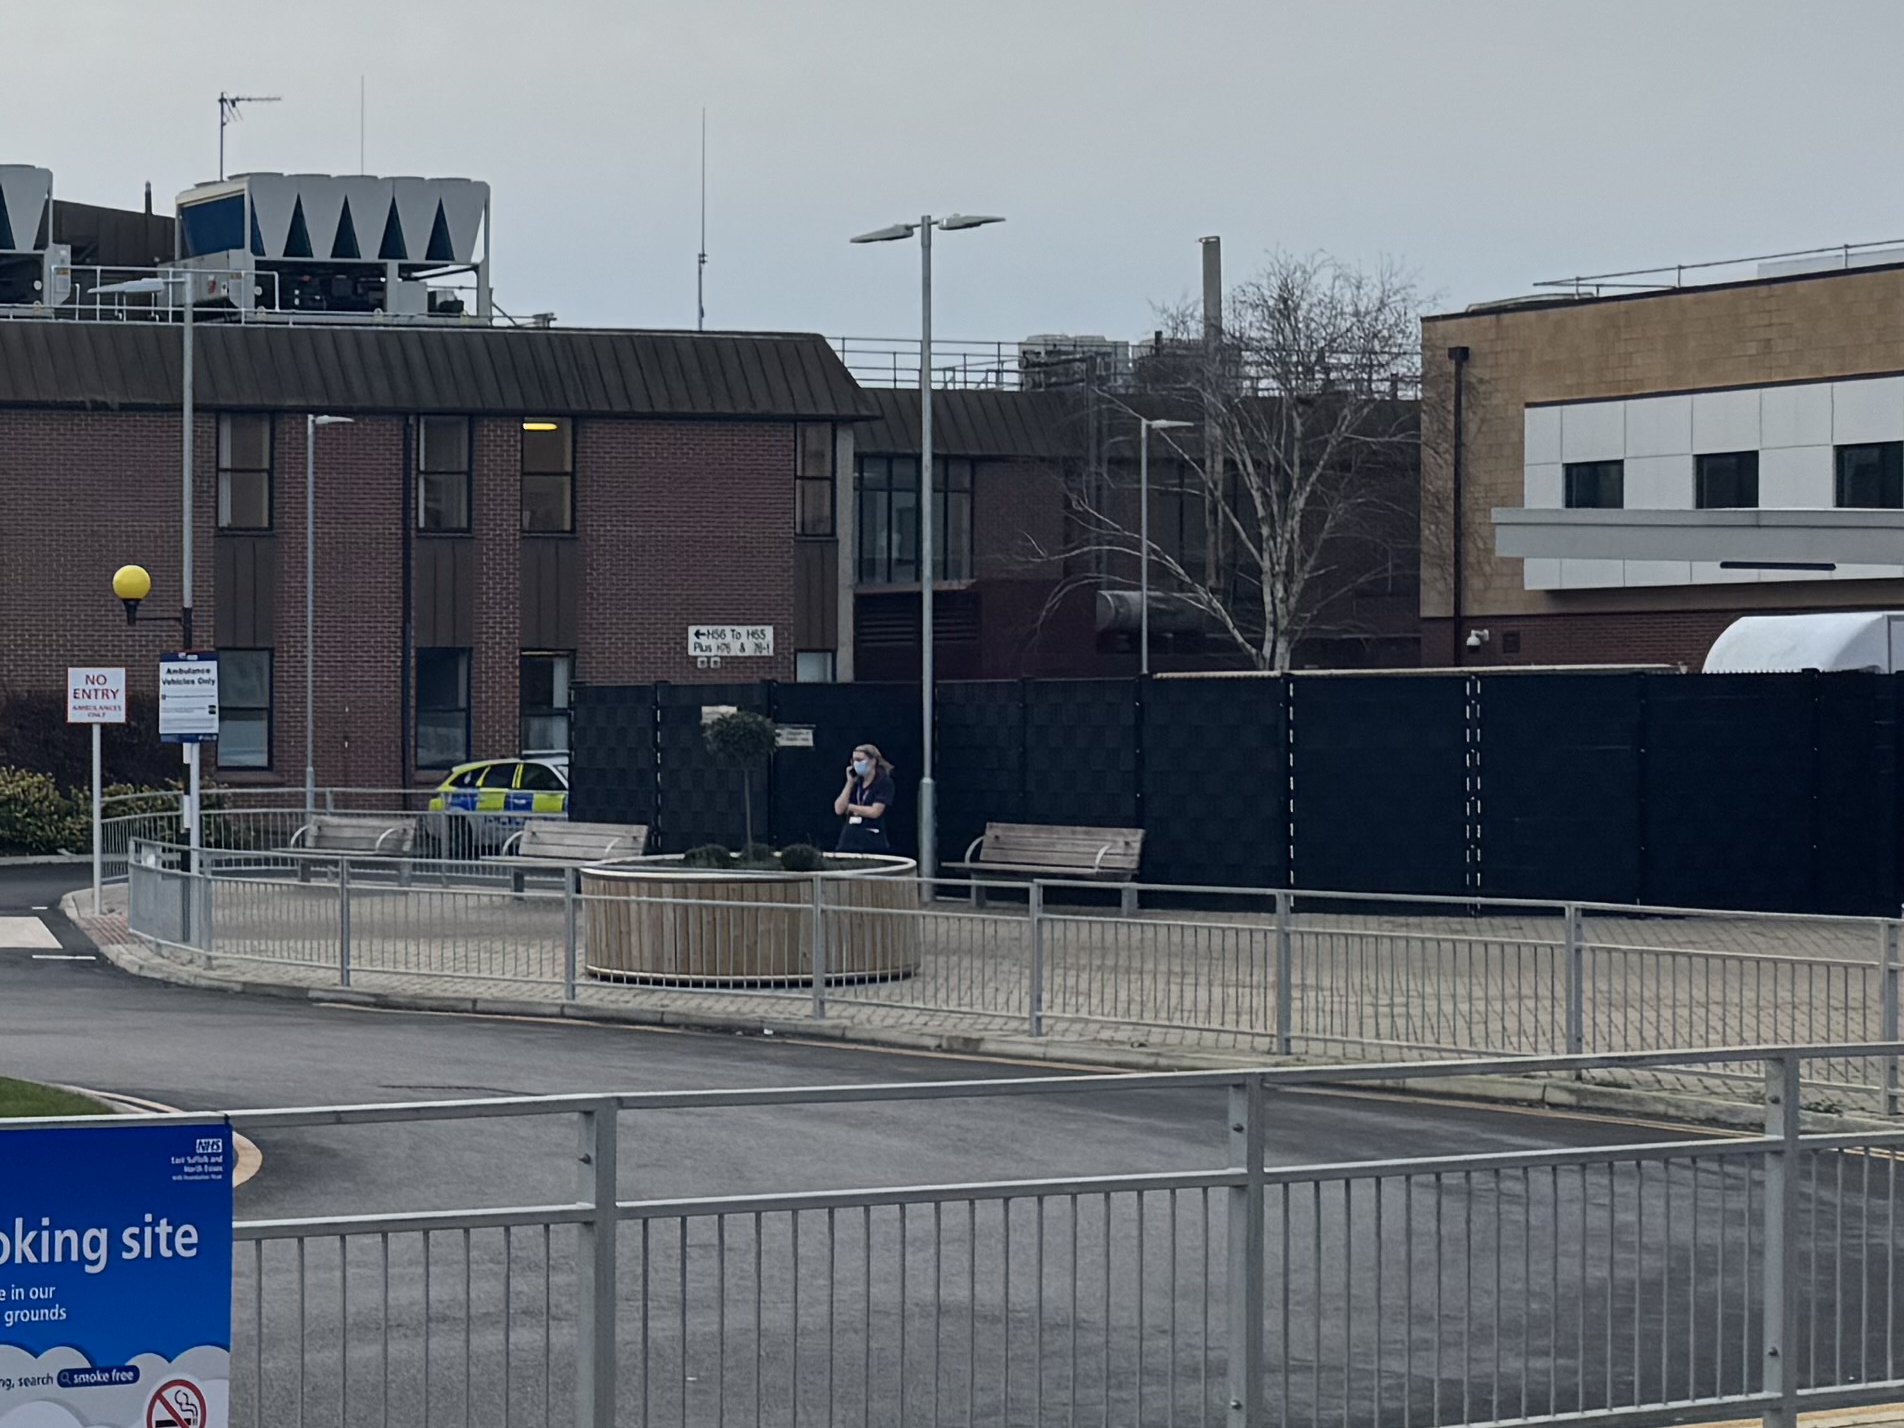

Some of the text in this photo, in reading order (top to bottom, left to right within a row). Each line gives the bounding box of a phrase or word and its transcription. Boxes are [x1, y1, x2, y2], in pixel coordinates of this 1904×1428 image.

[85, 674, 107, 685] NO
[73, 688, 119, 700] ENTRY
[121, 1213, 198, 1260] site
[11, 1285, 25, 1301] in
[29, 1286, 56, 1300] our
[4, 1304, 67, 1327] grounds
[18, 1374, 54, 1387] search
[72, 1370, 110, 1384] smoke
[111, 1369, 134, 1383] free
